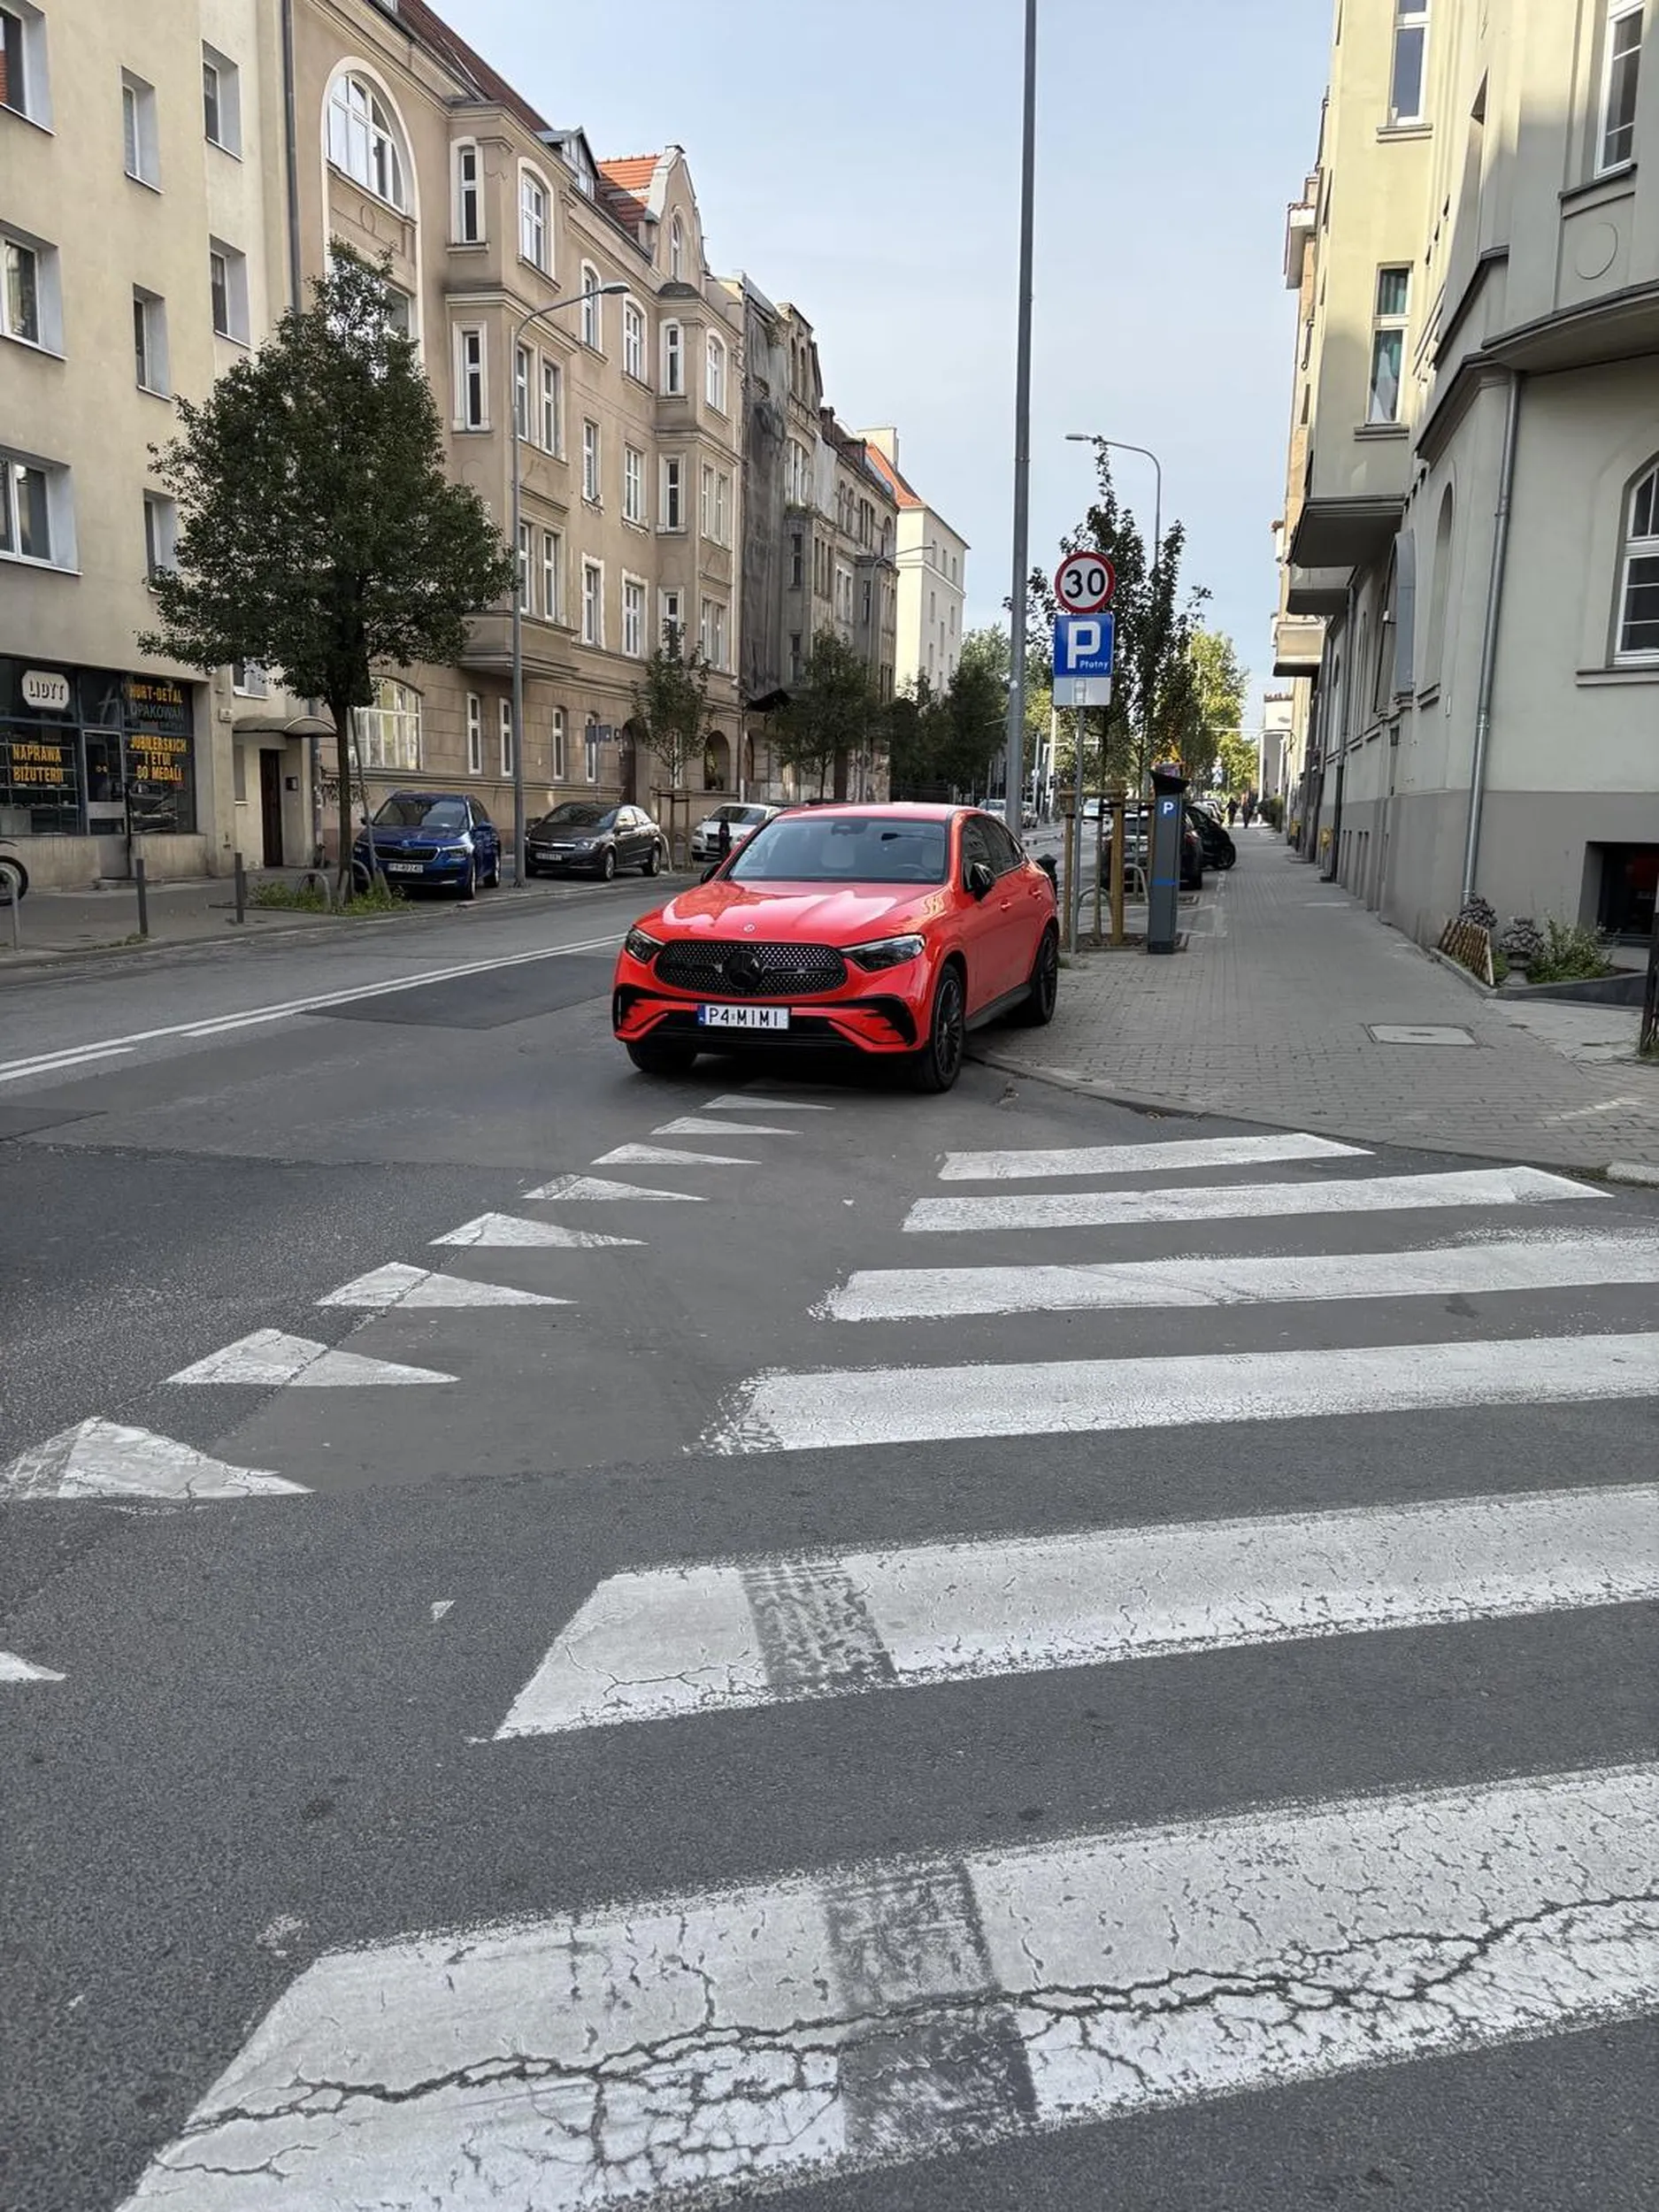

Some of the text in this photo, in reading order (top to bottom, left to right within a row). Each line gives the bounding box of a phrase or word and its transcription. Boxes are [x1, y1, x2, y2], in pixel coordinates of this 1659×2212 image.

[1064, 567, 1106, 599] 30
[1067, 620, 1102, 669] P
[13, 744, 62, 762] NAPRAWA
[1163, 802, 1174, 815] P
